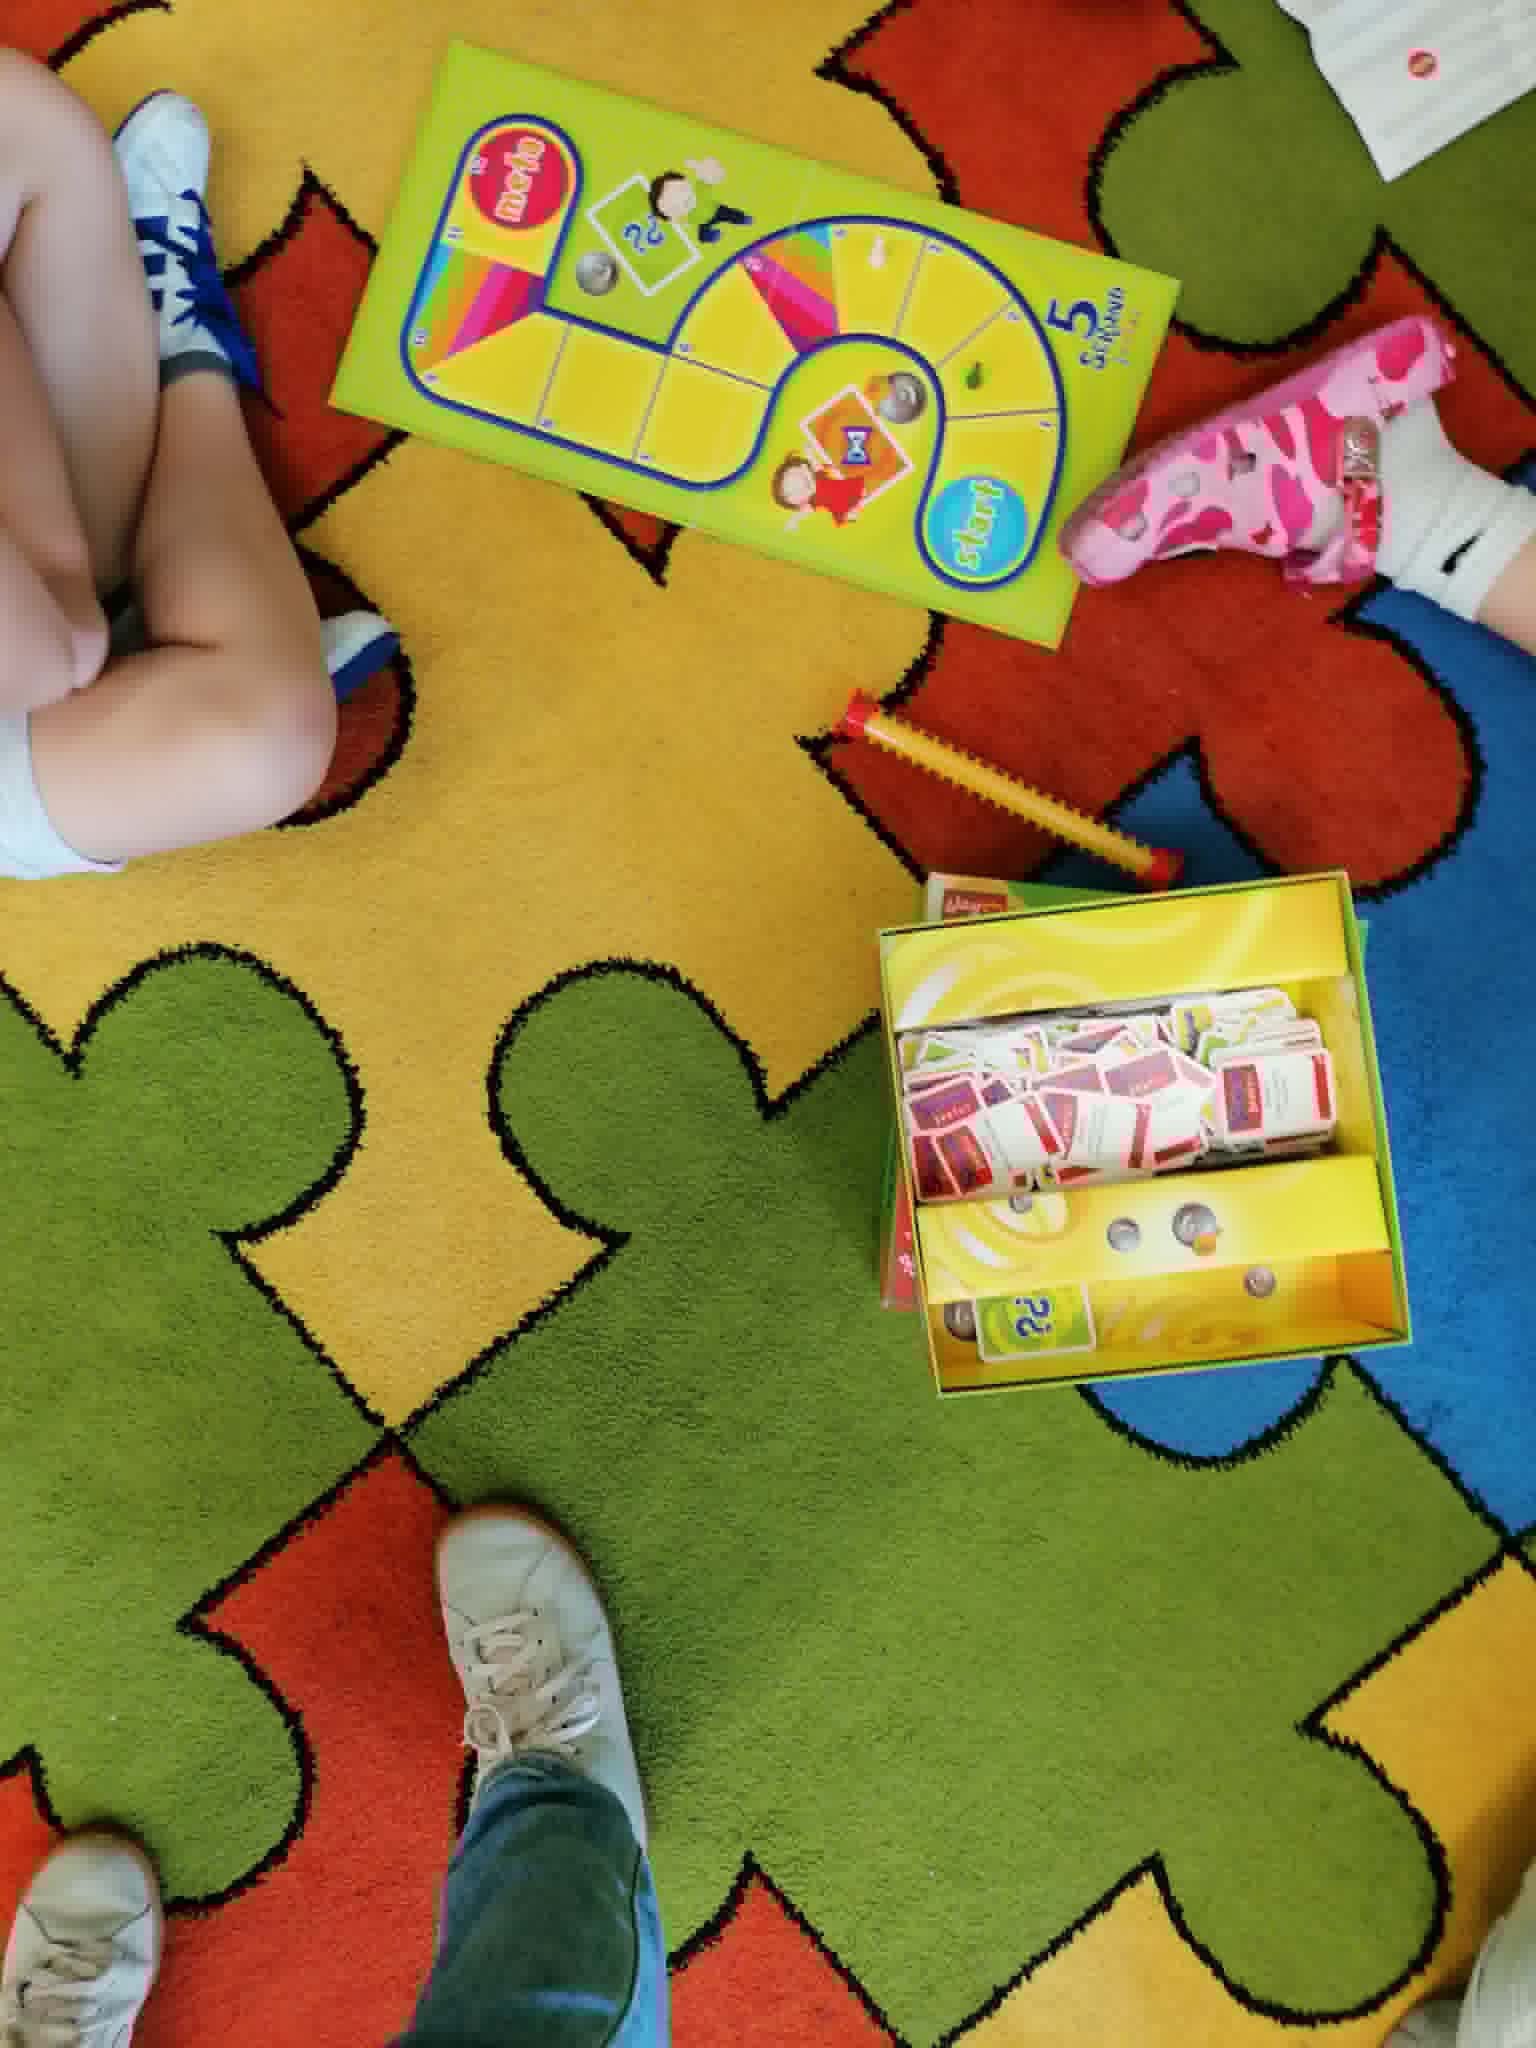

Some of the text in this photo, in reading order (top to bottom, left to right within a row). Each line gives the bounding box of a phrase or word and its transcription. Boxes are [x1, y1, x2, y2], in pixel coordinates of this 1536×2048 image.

[495, 136, 547, 223] meta
[1047, 298, 1100, 338] 5
[952, 478, 1005, 570] start
